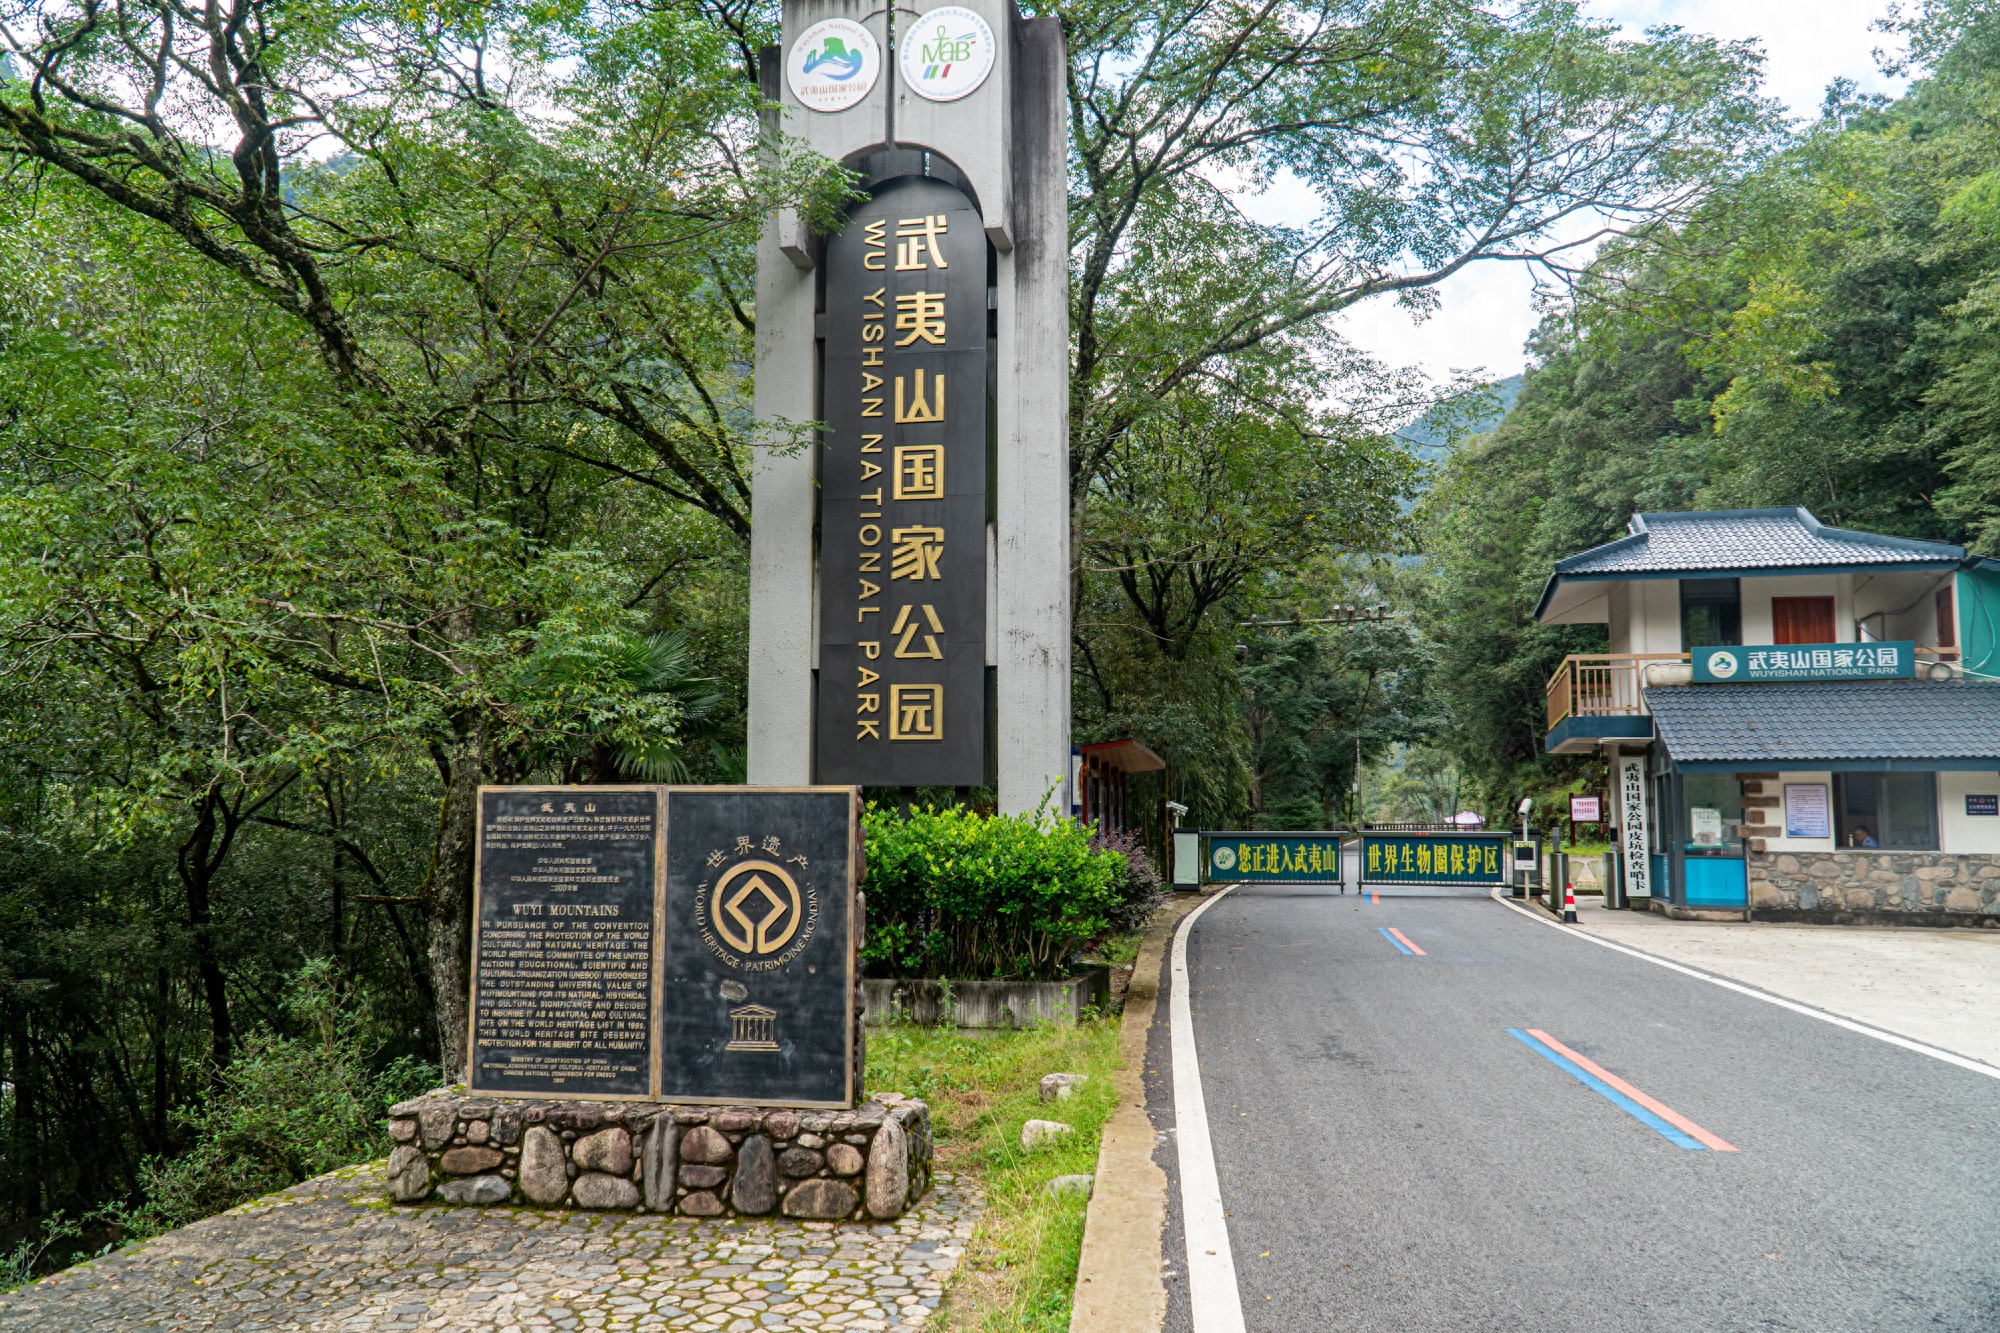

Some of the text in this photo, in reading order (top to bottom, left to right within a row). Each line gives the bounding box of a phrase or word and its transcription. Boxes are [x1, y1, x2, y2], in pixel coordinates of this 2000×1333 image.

[797, 23, 870, 52] Wuyishan National Park
[903, 64, 916, 85] UNESCO
[914, 83, 938, 97] Wuyishan
[955, 78, 979, 95] Biosphere
[978, 58, 990, 78] Reserve
[800, 82, 866, 96] 武夷山国家公园
[890, 214, 948, 741] 武夷山国家公园
[858, 434, 882, 622] NATIONAL
[1748, 648, 1898, 670] 武夷山国家公园
[1750, 667, 1898, 678] WUYISHAN NATIONAL PARK
[857, 641, 880, 740] PARK
[1624, 763, 1646, 890] 武夷山国家公园皮坑检查哨卡
[707, 835, 809, 870] 世界遗产
[1238, 843, 1336, 874] 您正进入武夷山
[1368, 843, 1498, 875] 世界生物圈保护区
[513, 904, 619, 916] WUYI MOUNTAINS
[482, 921, 491, 929] IN
[497, 921, 546, 929] PURSUANCE
[572, 922, 588, 930] THE
[594, 922, 649, 930] CONVENTION
[695, 883, 819, 972] WORLD HERITAGE PATRIMOINE MONDIAL
[482, 931, 526, 939] CONCERNING
[545, 932, 592, 940] PROTECTION
[594, 932, 604, 940] OF
[482, 941, 521, 949] CULTURAL
[526, 941, 542, 949] AND
[545, 941, 582, 949] NATURAL
[633, 942, 649, 950] THE
[624, 952, 649, 960] UNITED
[583, 962, 627, 970] SCIENTIFIC
[569, 971, 602, 979] (UNESCO)
[500, 980, 555, 988] OUTSTANDING
[559, 981, 602, 989] UNIVERSAL
[636, 982, 648, 990] OF
[539, 990, 553, 998] FOR
[606, 992, 647, 1000] HISTORICAL
[498, 1000, 537, 1008] CULTURAL
[540, 1000, 593, 1009] SIGNIFICANCE
[614, 1002, 647, 1010] DECIDED
[491, 1010, 524, 1018] INSCRIBE
[526, 1010, 533, 1018] IT
[555, 1011, 589, 1019] NATURAL
[591, 1011, 607, 1019] AND
[609, 1012, 647, 1020] CULTURAL
[479, 1019, 496, 1027] SITE
[511, 1020, 526, 1028] THE
[528, 1020, 554, 1028] WORLD
[556, 1021, 595, 1029] HERITAGE
[597, 1021, 615, 1029] LIST
[617, 1021, 625, 1029] IN
[732, 1018, 775, 1040] UNESCO
[501, 1029, 531, 1038] WORLD
[535, 1030, 575, 1038] HERITAGE
[580, 1031, 598, 1039] SITE
[603, 1031, 646, 1039] DESERVES
[478, 1039, 521, 1047] PROTECTION
[539, 1040, 552, 1048] THE
[553, 1040, 581, 1049] BENEFIT
[594, 1041, 607, 1049] ALL
